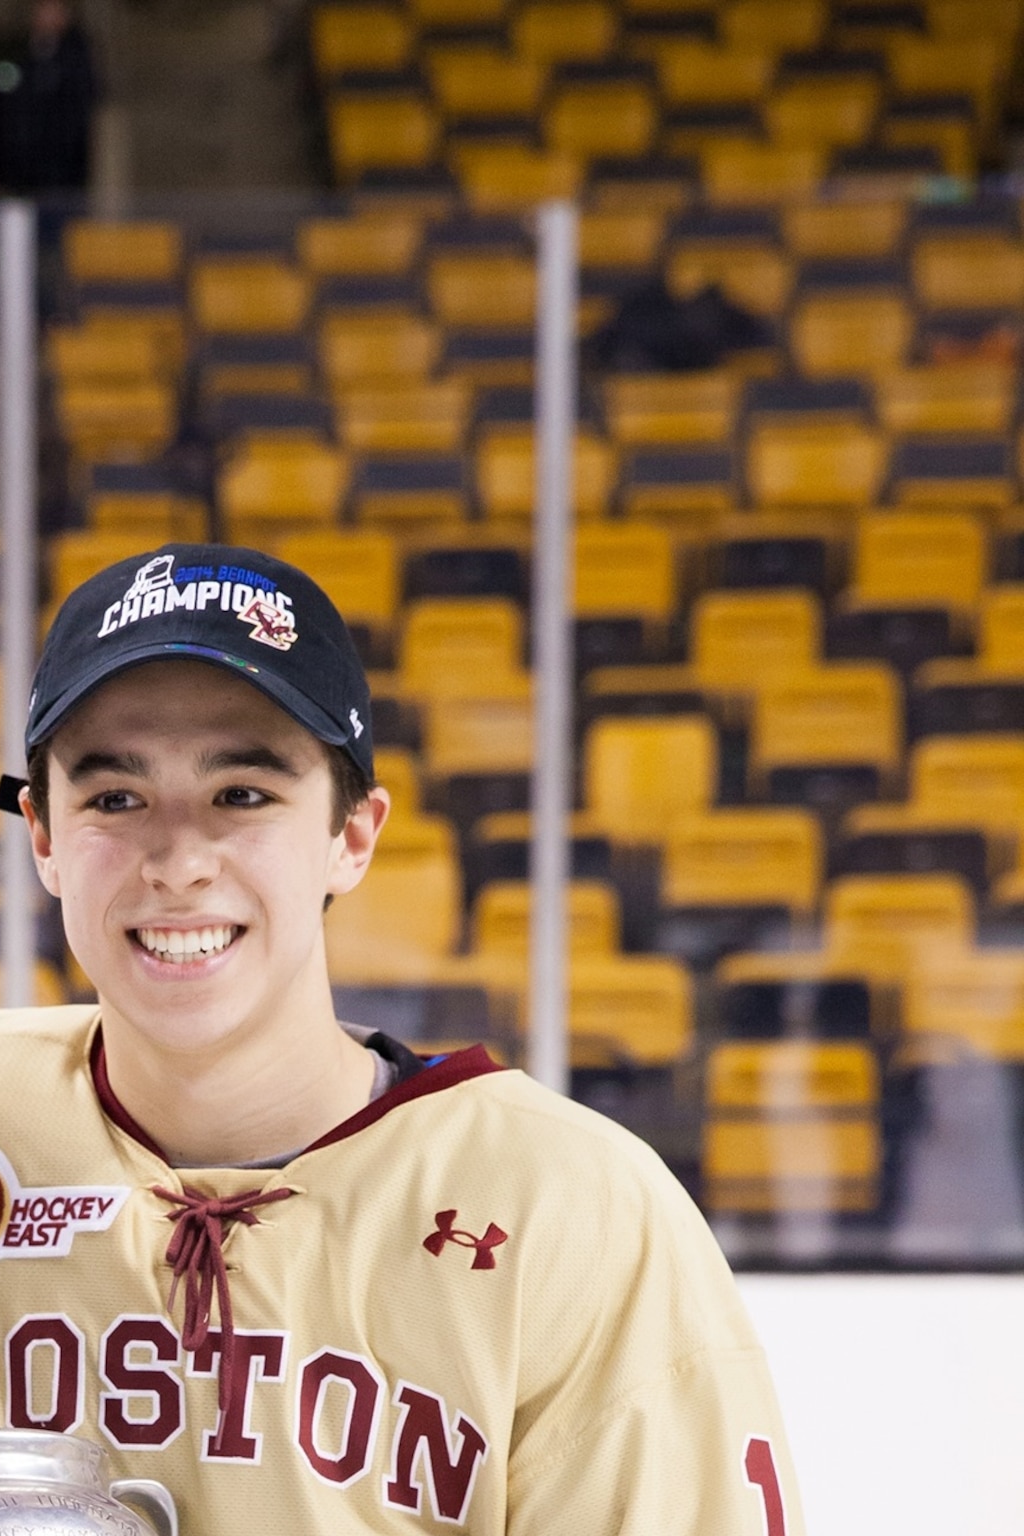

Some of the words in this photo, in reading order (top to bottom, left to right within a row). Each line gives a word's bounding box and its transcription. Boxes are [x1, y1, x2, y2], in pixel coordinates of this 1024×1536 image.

[176, 566, 214, 583] 2014
[10, 1196, 115, 1223] HOCKEY
[3, 1222, 68, 1248] EAST
